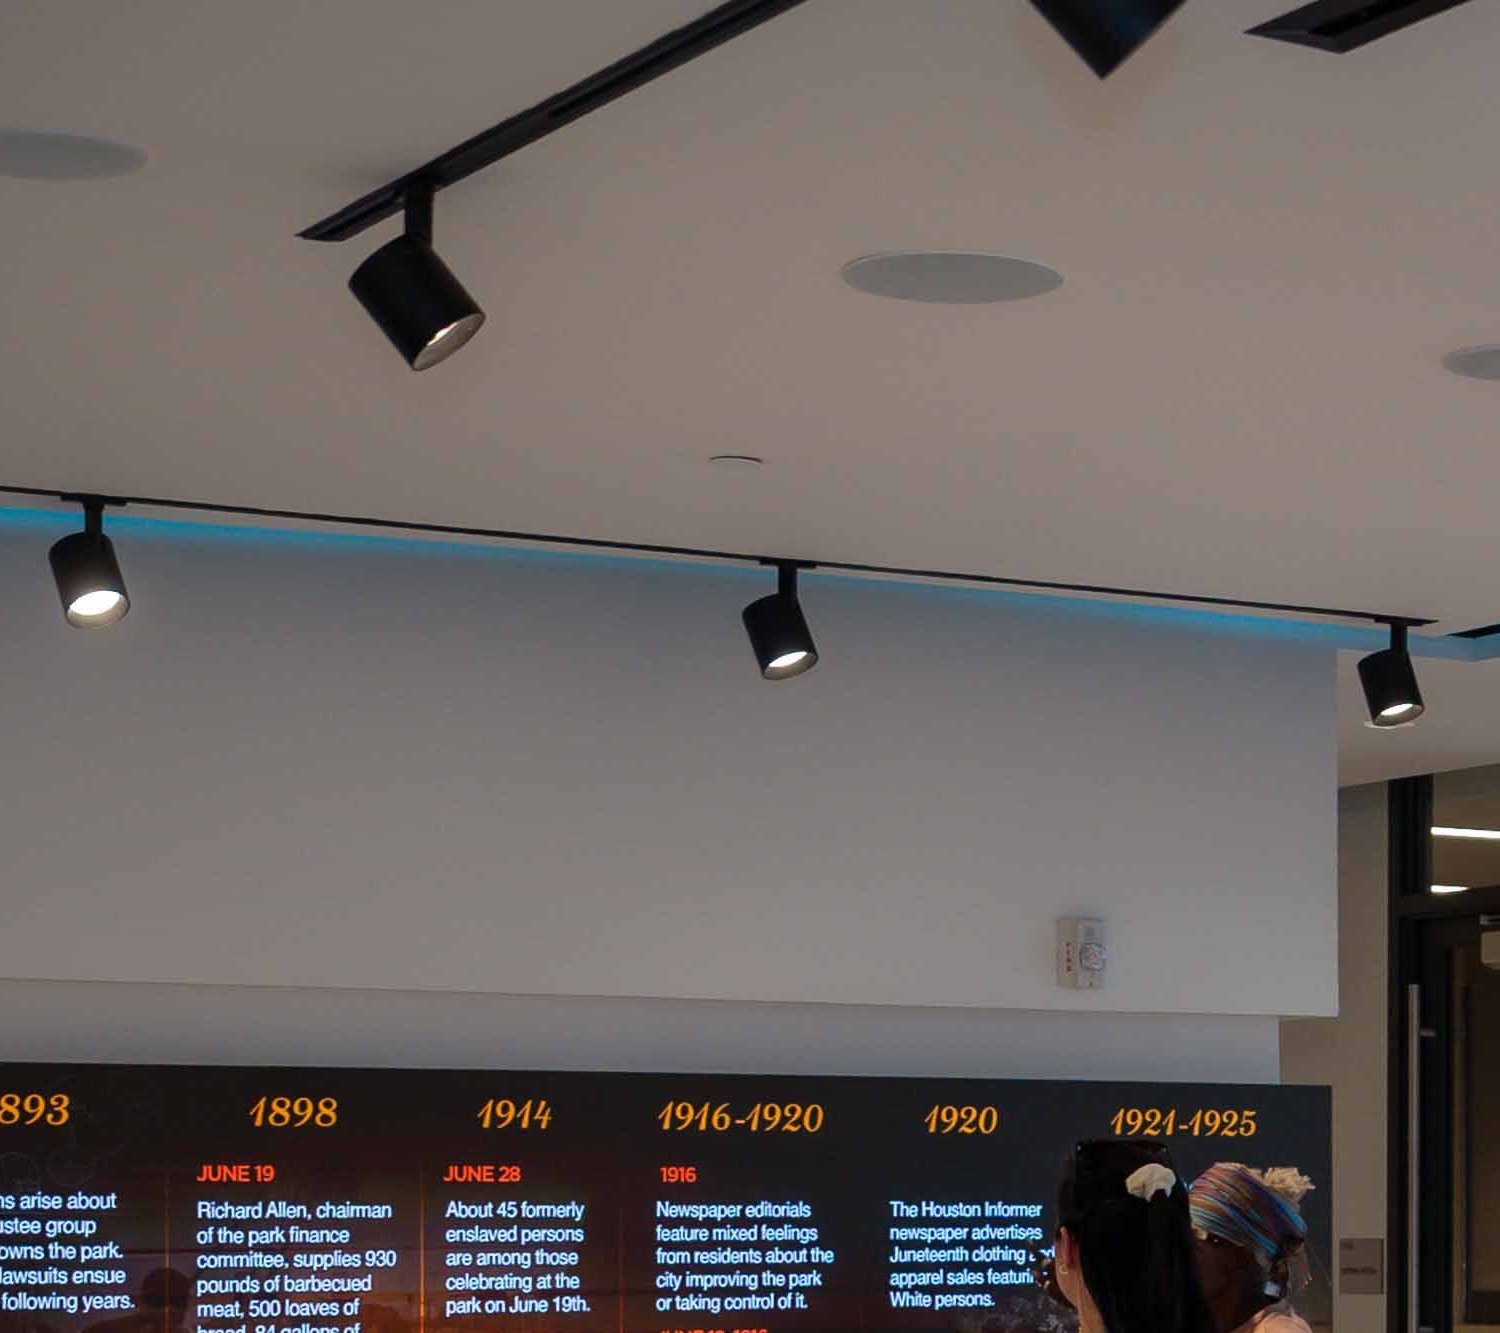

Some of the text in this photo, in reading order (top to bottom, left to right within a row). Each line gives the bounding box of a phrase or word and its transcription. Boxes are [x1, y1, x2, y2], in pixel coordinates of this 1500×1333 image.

[248, 1097, 338, 1127] 1898
[476, 1100, 550, 1130] 1914
[659, 1102, 825, 1133] 1916-1920
[925, 1106, 999, 1135] 1920
[1110, 1109, 1257, 1137] 1921-1925
[196, 1164, 276, 1182] JUNE 19
[443, 1165, 522, 1183] JUNE 28
[660, 1166, 697, 1183] 1916
[19, 1191, 63, 1210] arise
[66, 1191, 117, 1210] about
[197, 1200, 392, 1220] Richard Allen, chairman
[444, 1200, 586, 1222] About 45 formerly
[656, 1200, 812, 1222] Newspaper editorials
[889, 1200, 1043, 1218] The Houston Informer
[44, 1220, 97, 1238] group
[445, 1224, 585, 1246] enslaved persons
[655, 1224, 819, 1244] feature mixed feelings
[889, 1223, 1044, 1244] newspaper advertises
[47, 1241, 77, 1260] the
[80, 1240, 124, 1264] park.
[196, 1249, 398, 1272] committee, supplies 930
[445, 1248, 579, 1270] are among those
[655, 1246, 834, 1265] from residents about the
[889, 1246, 970, 1264] Juneteenth
[972, 1245, 1025, 1265] clothing
[71, 1269, 127, 1284] ensue
[196, 1273, 372, 1298] pounds of barbecued
[444, 1271, 580, 1294] celebrating at the
[655, 1269, 822, 1292] city improving the park
[889, 1268, 1047, 1289] apparel sales featuri
[196, 1297, 360, 1319] meat, 500 loaves of
[445, 1294, 591, 1318] park on June 19th.
[889, 1290, 996, 1311] White persons.
